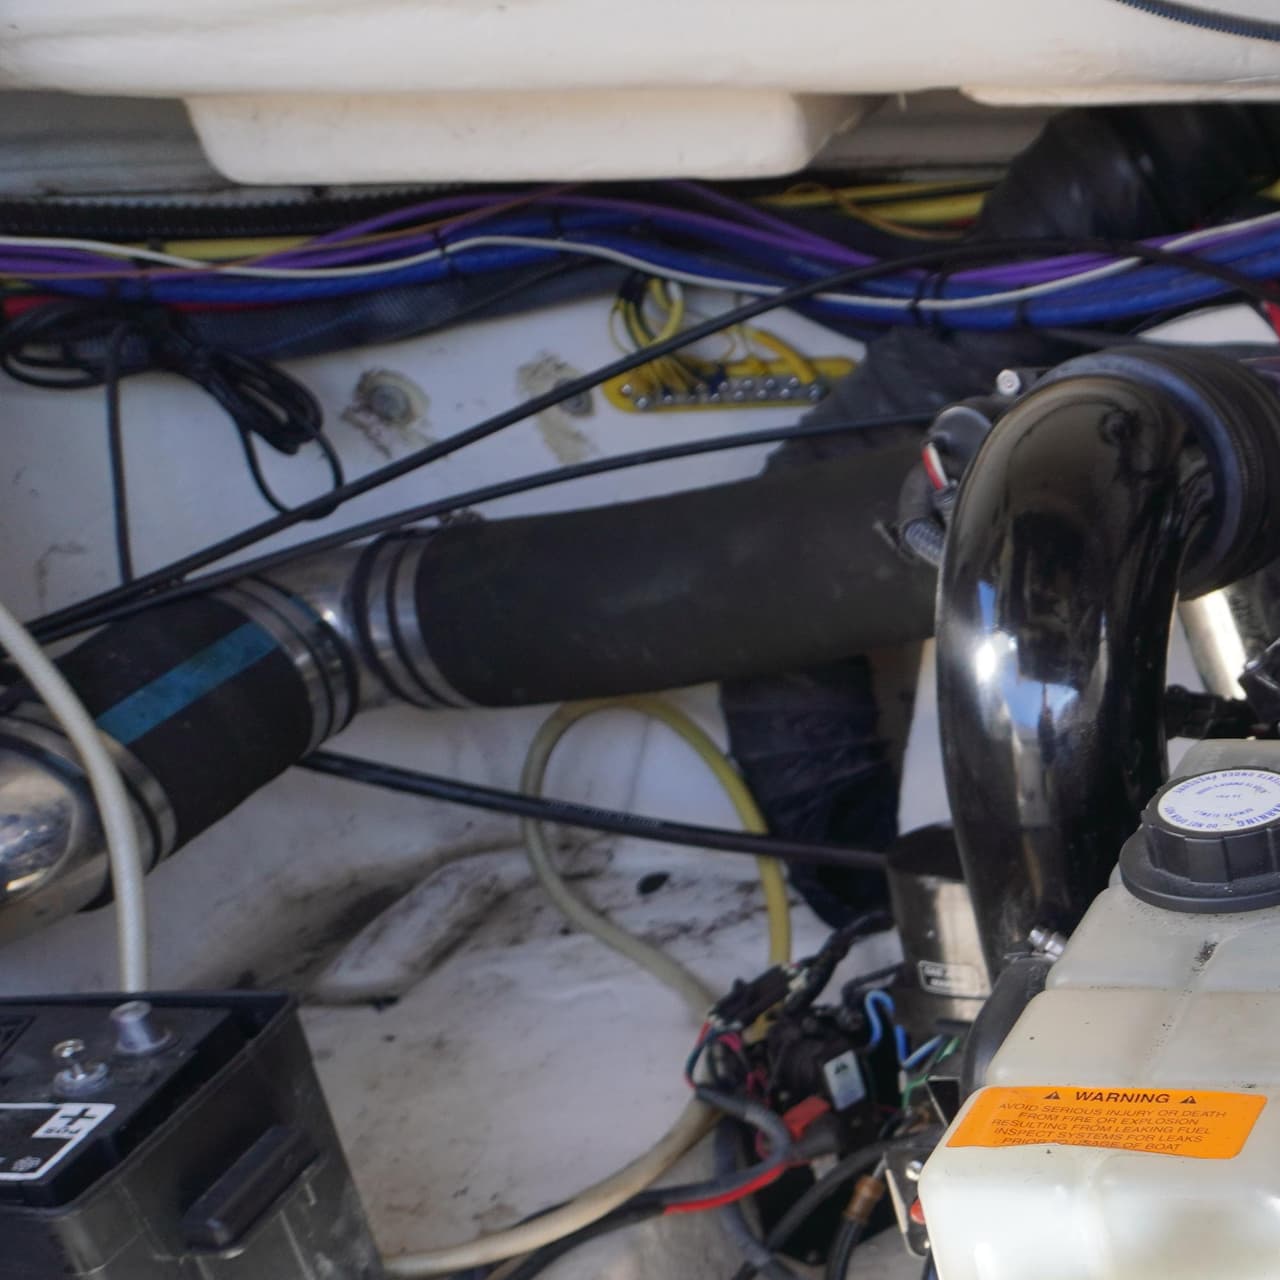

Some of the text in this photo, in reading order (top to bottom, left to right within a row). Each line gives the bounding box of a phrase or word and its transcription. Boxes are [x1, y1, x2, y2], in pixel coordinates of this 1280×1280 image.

[1074, 1090, 1171, 1104] WARNING
[1000, 1103, 1228, 1118] AVOID SERIOUS INJURY OR DEATH
[1018, 1112, 1200, 1126] FROM FIRE OR EXPLOSION
[992, 1119, 1068, 1130] RESULTING
[1071, 1124, 1112, 1132] FROM
[1115, 1126, 1174, 1134] LEAKING
[993, 1128, 1056, 1138] INSPECT
[1057, 1131, 1123, 1141] SYSTEMS
